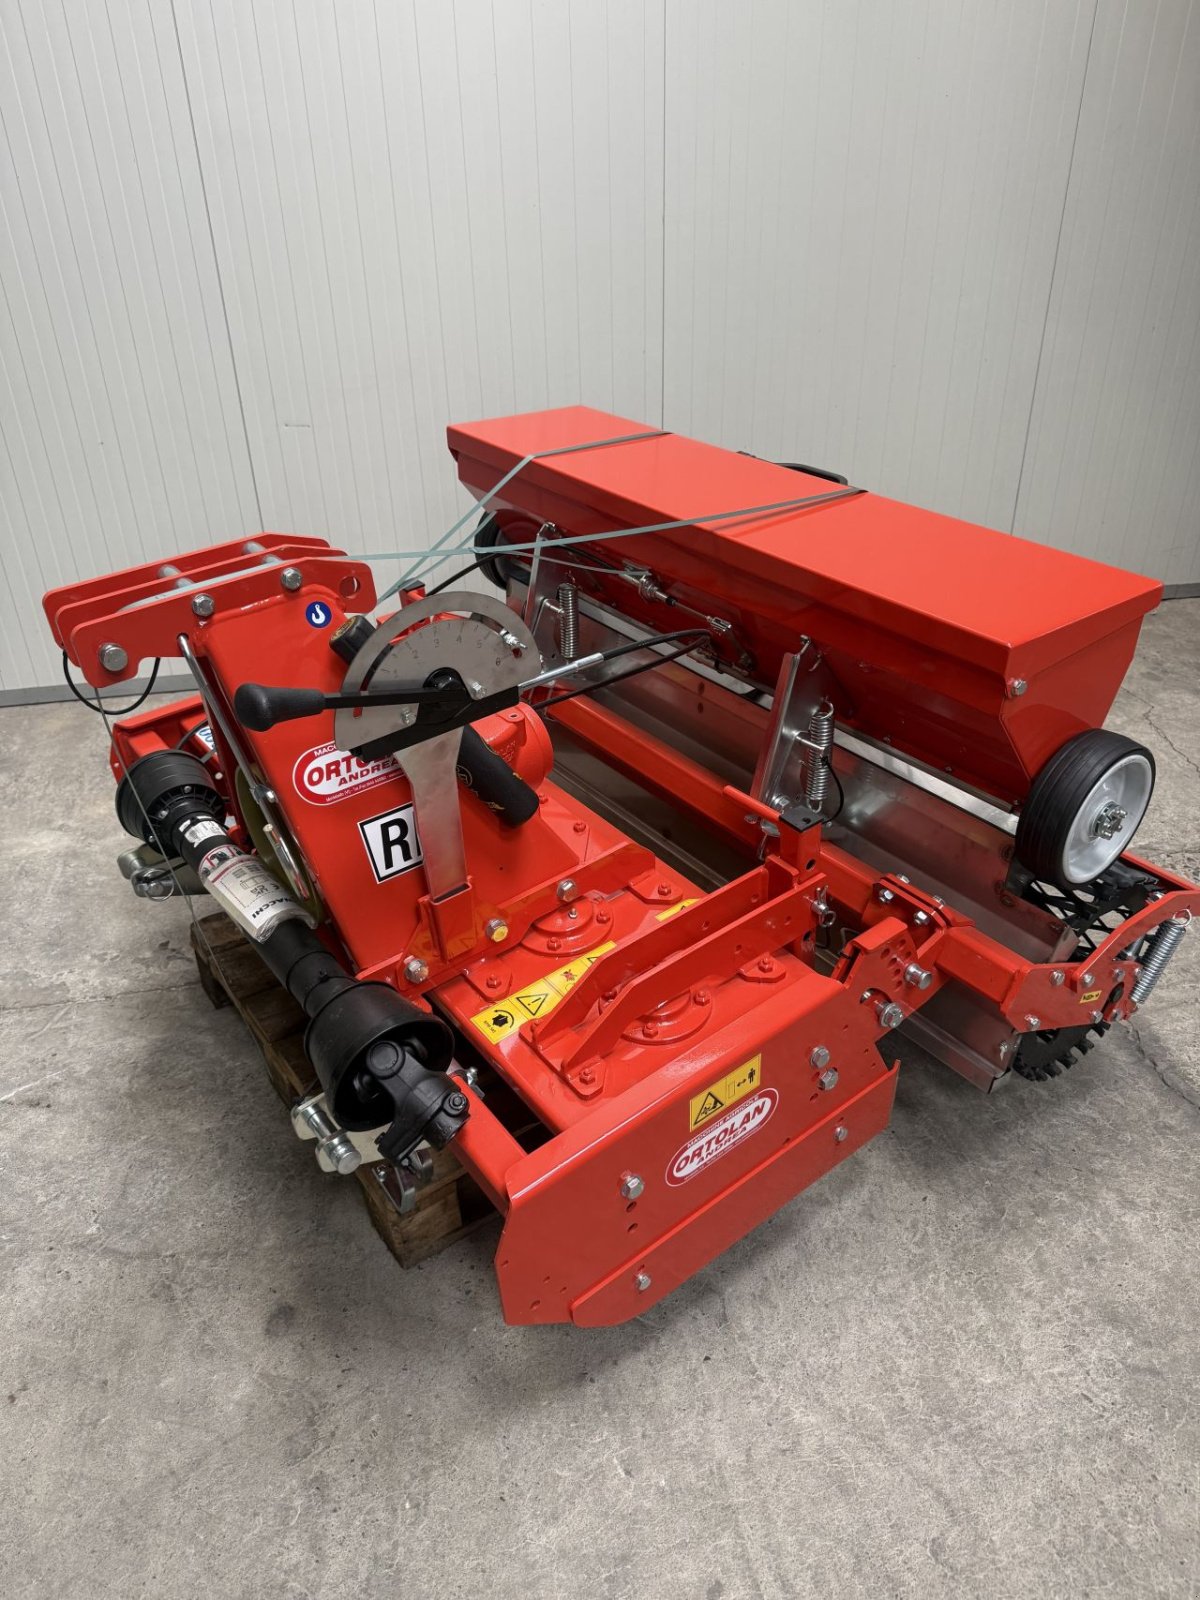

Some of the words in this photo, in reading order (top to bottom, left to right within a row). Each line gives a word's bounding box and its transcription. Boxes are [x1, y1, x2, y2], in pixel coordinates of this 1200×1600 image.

[495, 657, 501, 666] 6
[338, 758, 399, 787] ANDREA
[675, 1100, 767, 1173] ORTOLAN
[697, 1126, 747, 1165] ANDREA
